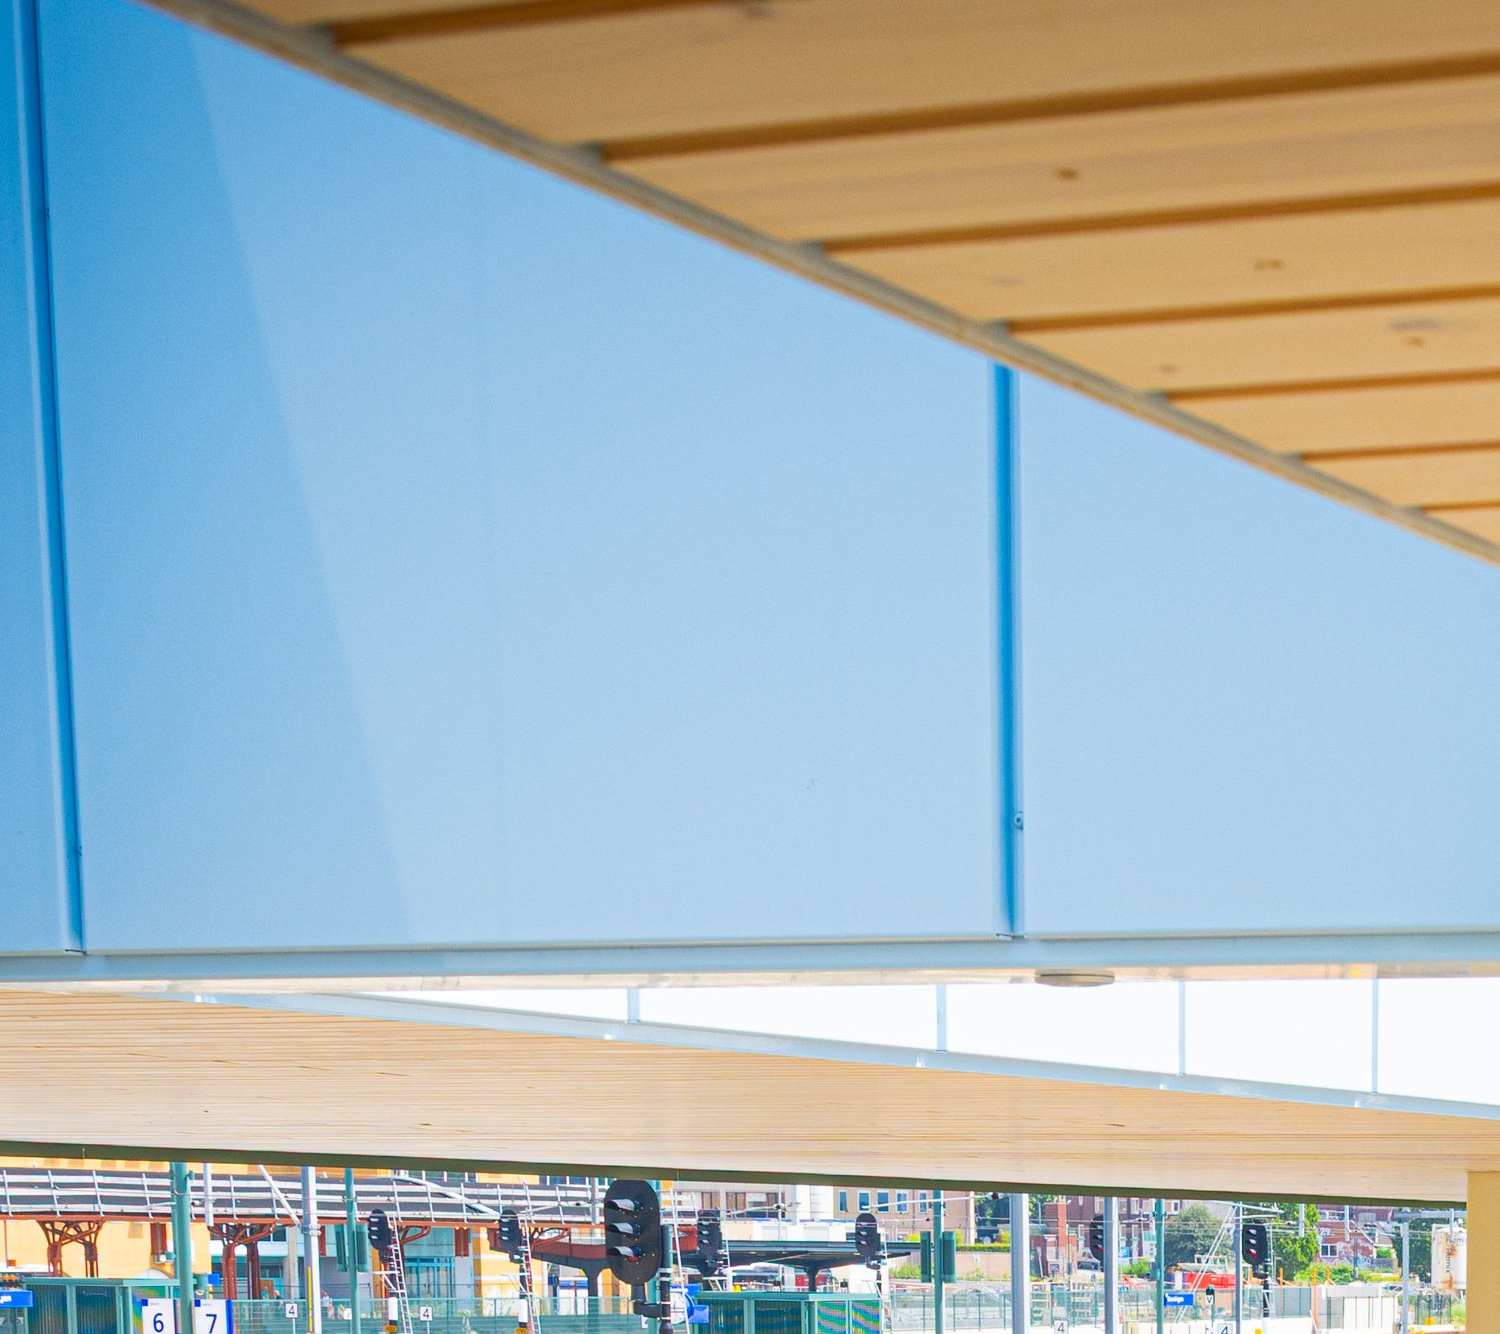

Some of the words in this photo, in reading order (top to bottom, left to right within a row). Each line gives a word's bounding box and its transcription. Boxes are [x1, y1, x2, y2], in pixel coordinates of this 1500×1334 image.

[288, 1305, 296, 1315] 4
[423, 1308, 430, 1319] 4
[152, 1312, 165, 1334] 6
[205, 1313, 218, 1334] 7
[1057, 1322, 1065, 1334] 4
